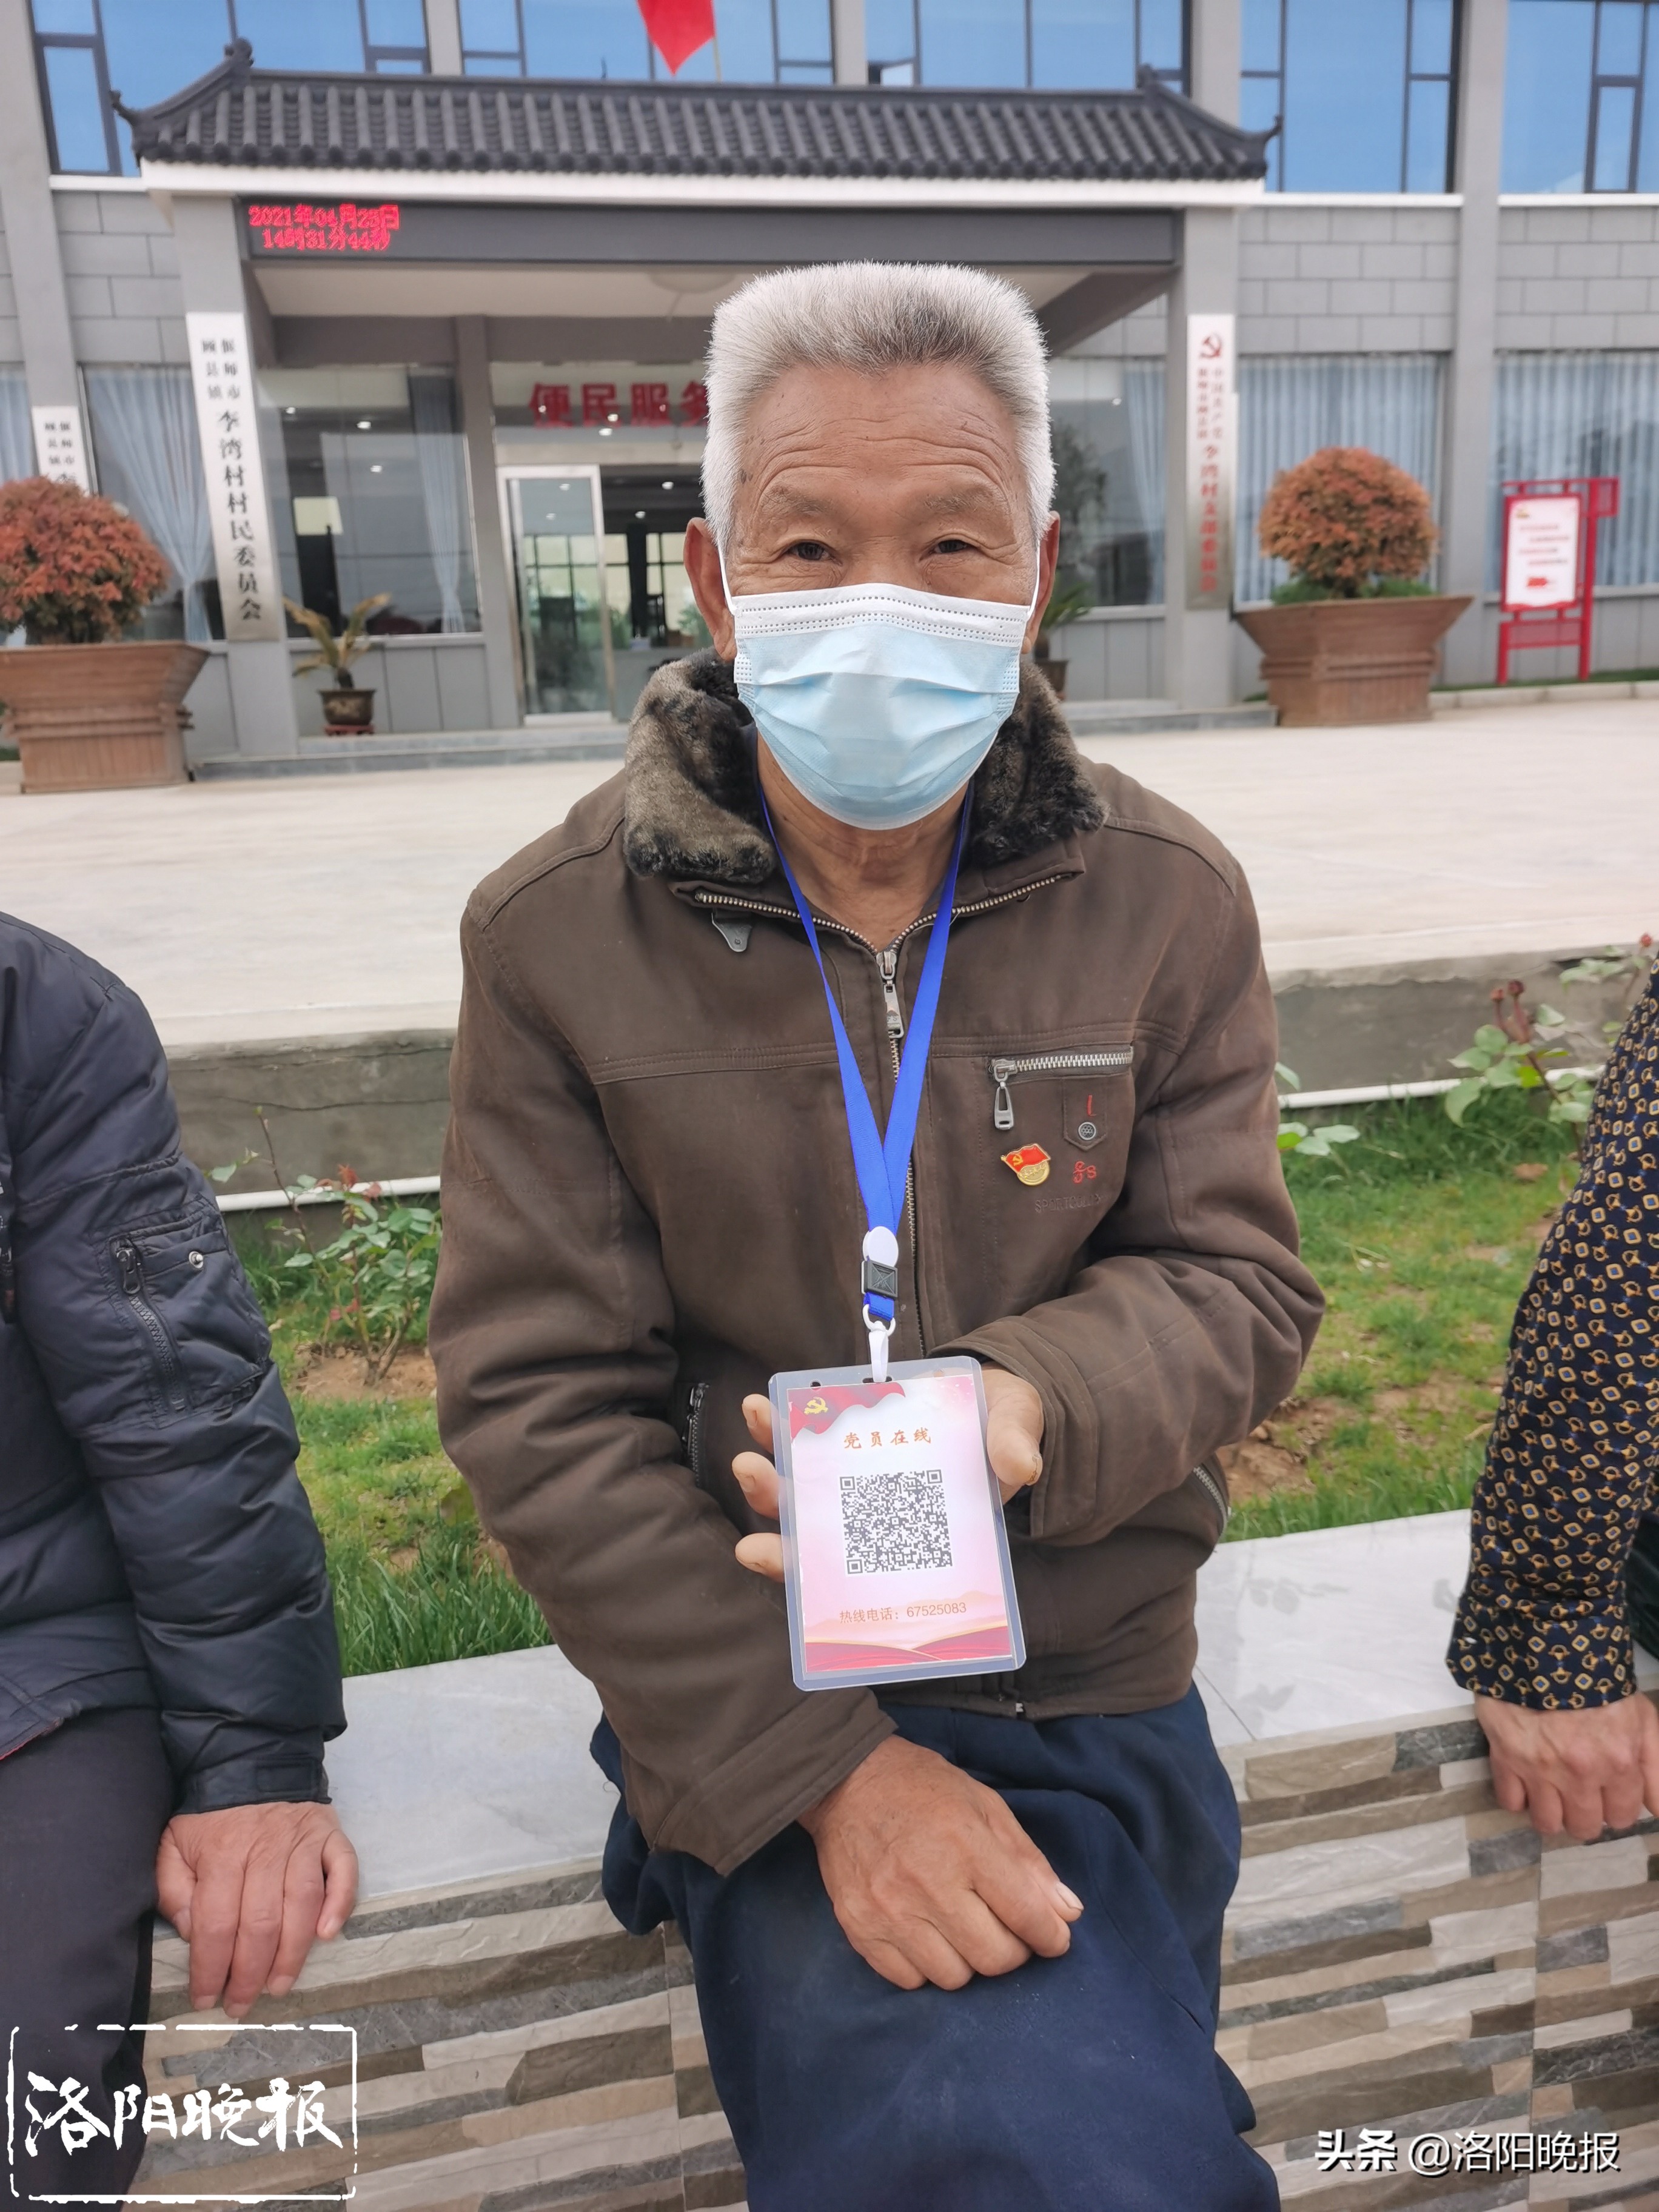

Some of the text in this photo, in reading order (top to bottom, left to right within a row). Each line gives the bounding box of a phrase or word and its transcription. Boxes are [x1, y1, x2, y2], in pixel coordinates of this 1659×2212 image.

[528, 380, 708, 428] 便民服务
[217, 410, 261, 620] 李湾村村民委员会
[843, 1427, 931, 1449] 党员在线
